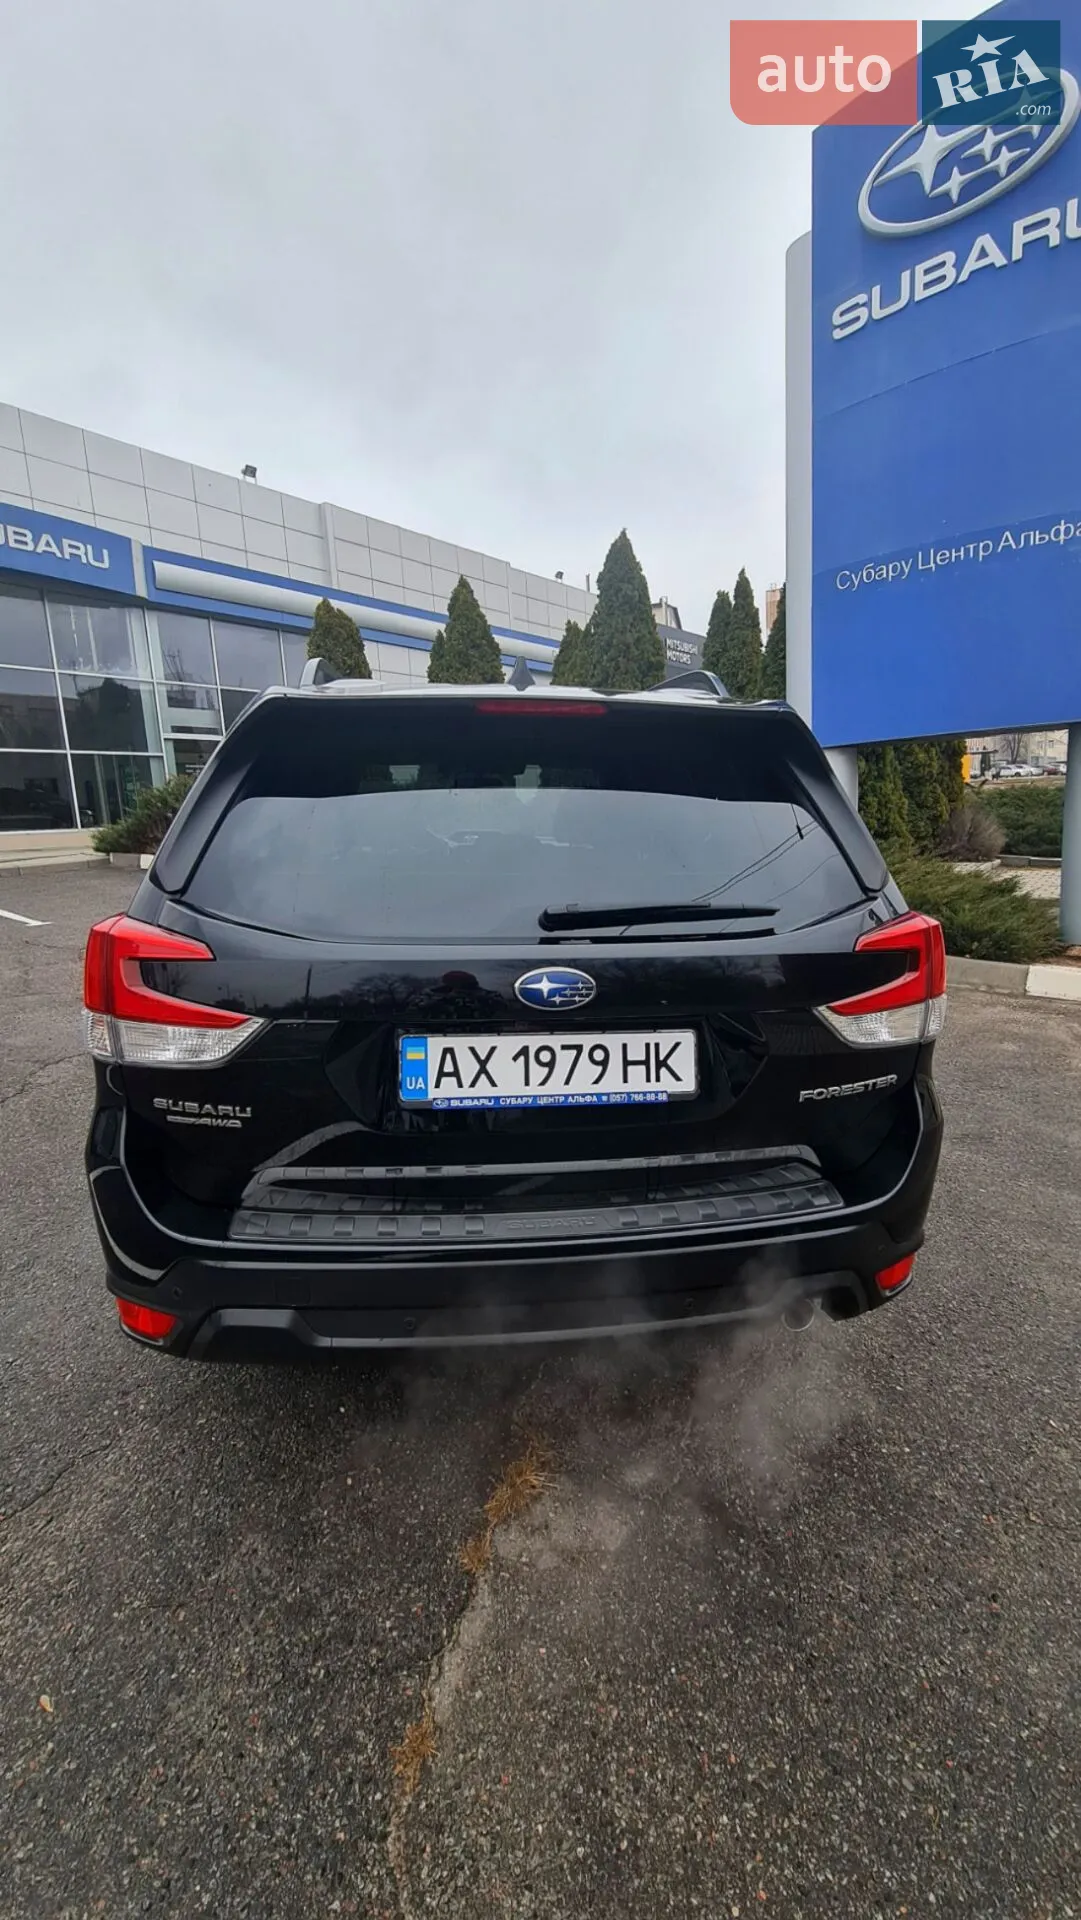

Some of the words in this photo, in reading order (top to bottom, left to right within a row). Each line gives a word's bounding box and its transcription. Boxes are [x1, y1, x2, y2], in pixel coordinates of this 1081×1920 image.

[0, 523, 110, 569] BARU
[836, 558, 912, 591] Субару
[918, 540, 993, 572] Центр
[666, 638, 698, 655] MITSUBISHI
[666, 649, 691, 664] MOTORS
[434, 1046, 498, 1089] AX
[511, 1043, 611, 1087] 1979
[621, 1041, 683, 1084] HK
[406, 1077, 426, 1090] UA
[799, 1073, 898, 1103] FORESTER
[153, 1098, 252, 1117] SUBARU
[450, 1097, 495, 1106] SUBARU
[499, 1096, 534, 1105] СУБАРУ
[537, 1095, 565, 1105] ЦЕНТР
[567, 1094, 598, 1103] АЛЬФА
